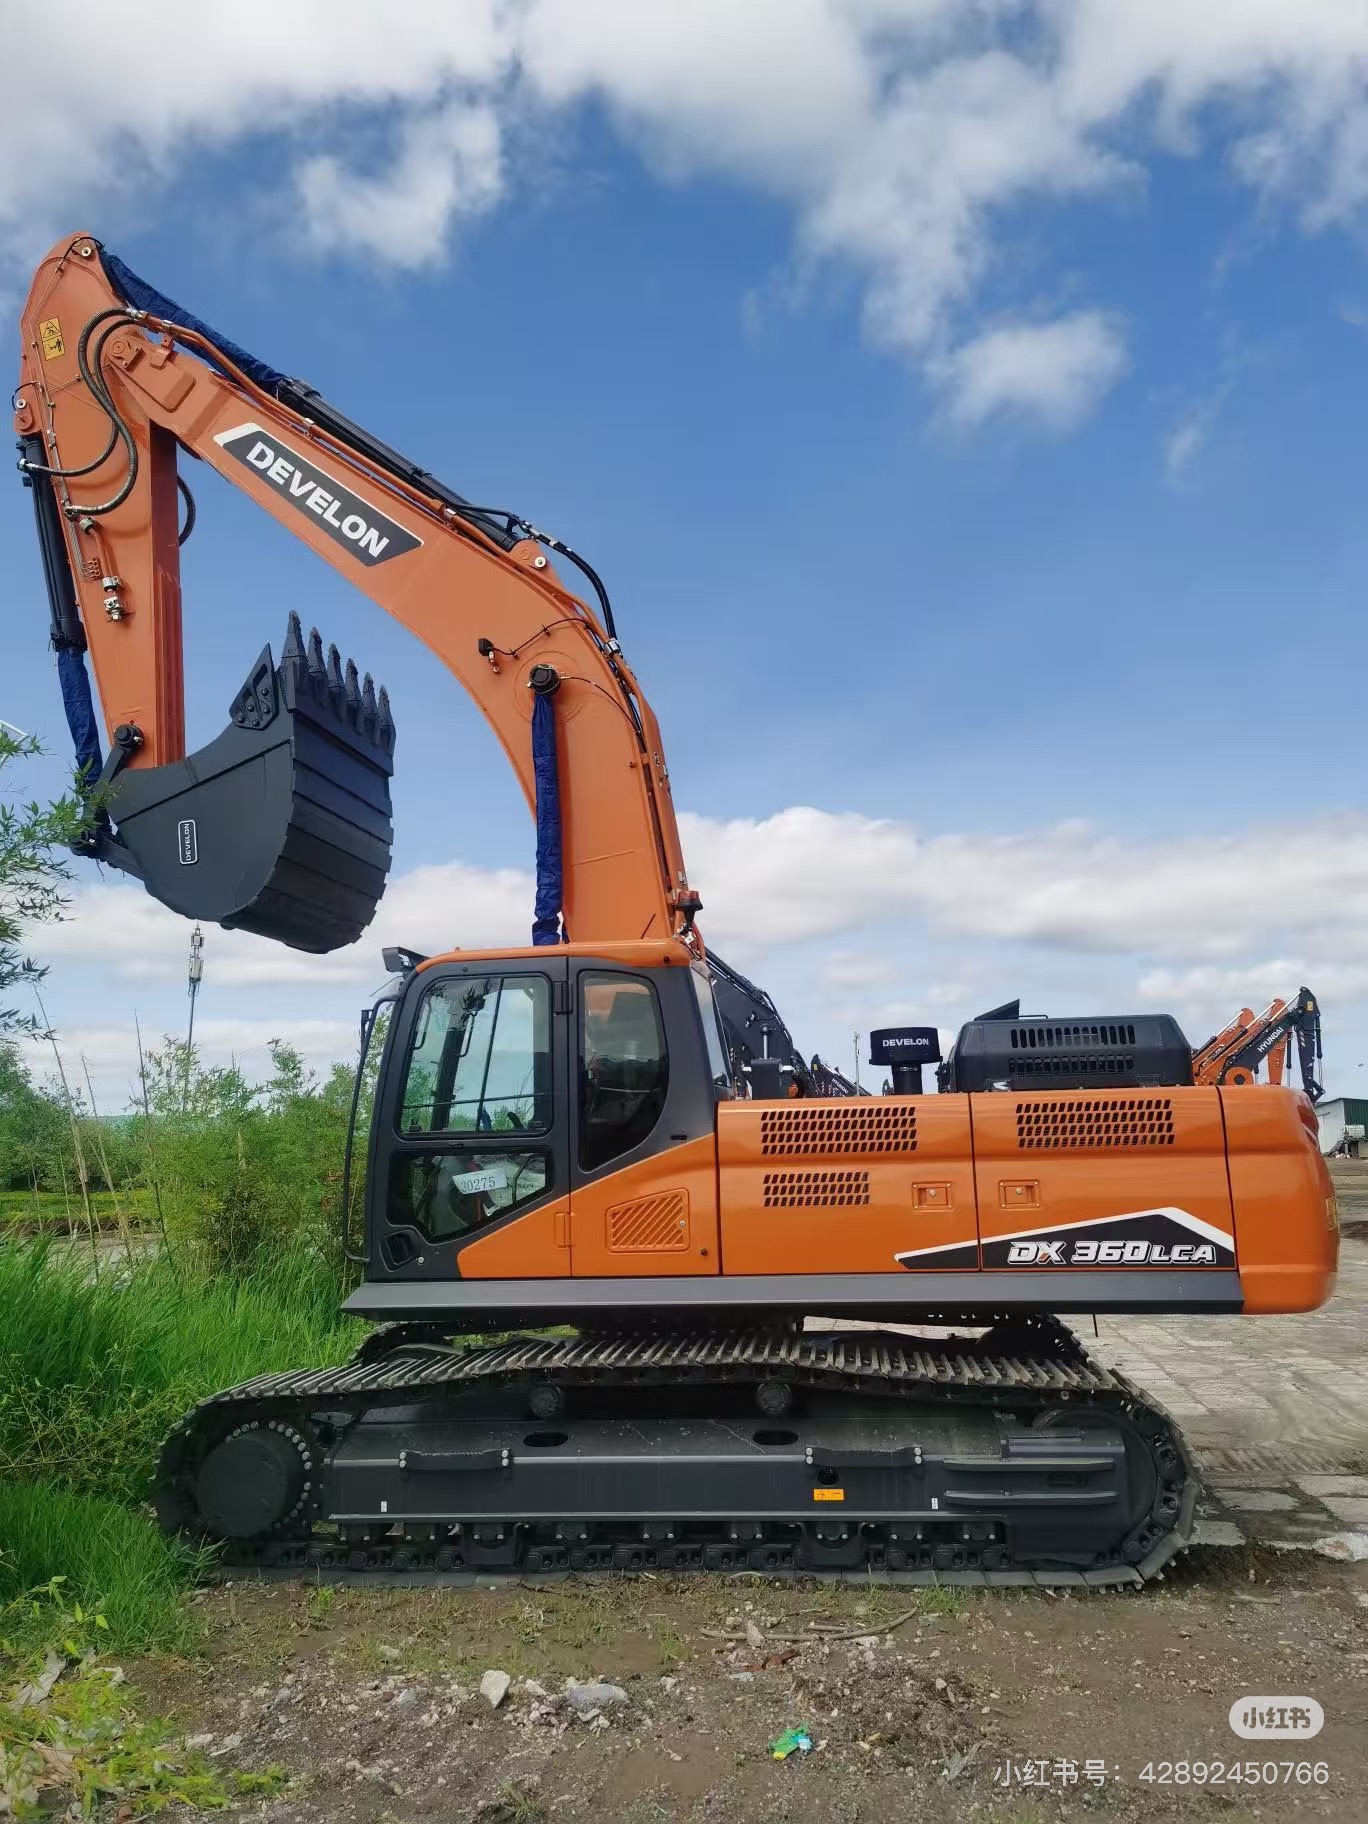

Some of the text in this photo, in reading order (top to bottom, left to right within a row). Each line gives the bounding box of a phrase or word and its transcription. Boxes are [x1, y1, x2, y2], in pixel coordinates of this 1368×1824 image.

[246, 441, 390, 558] DEVELON
[184, 823, 192, 861] DEVELON
[882, 1038, 929, 1047] DEVELON
[1257, 1026, 1285, 1053] HYUNDAI
[462, 1175, 496, 1193] 30275
[1007, 1240, 1067, 1264] DX
